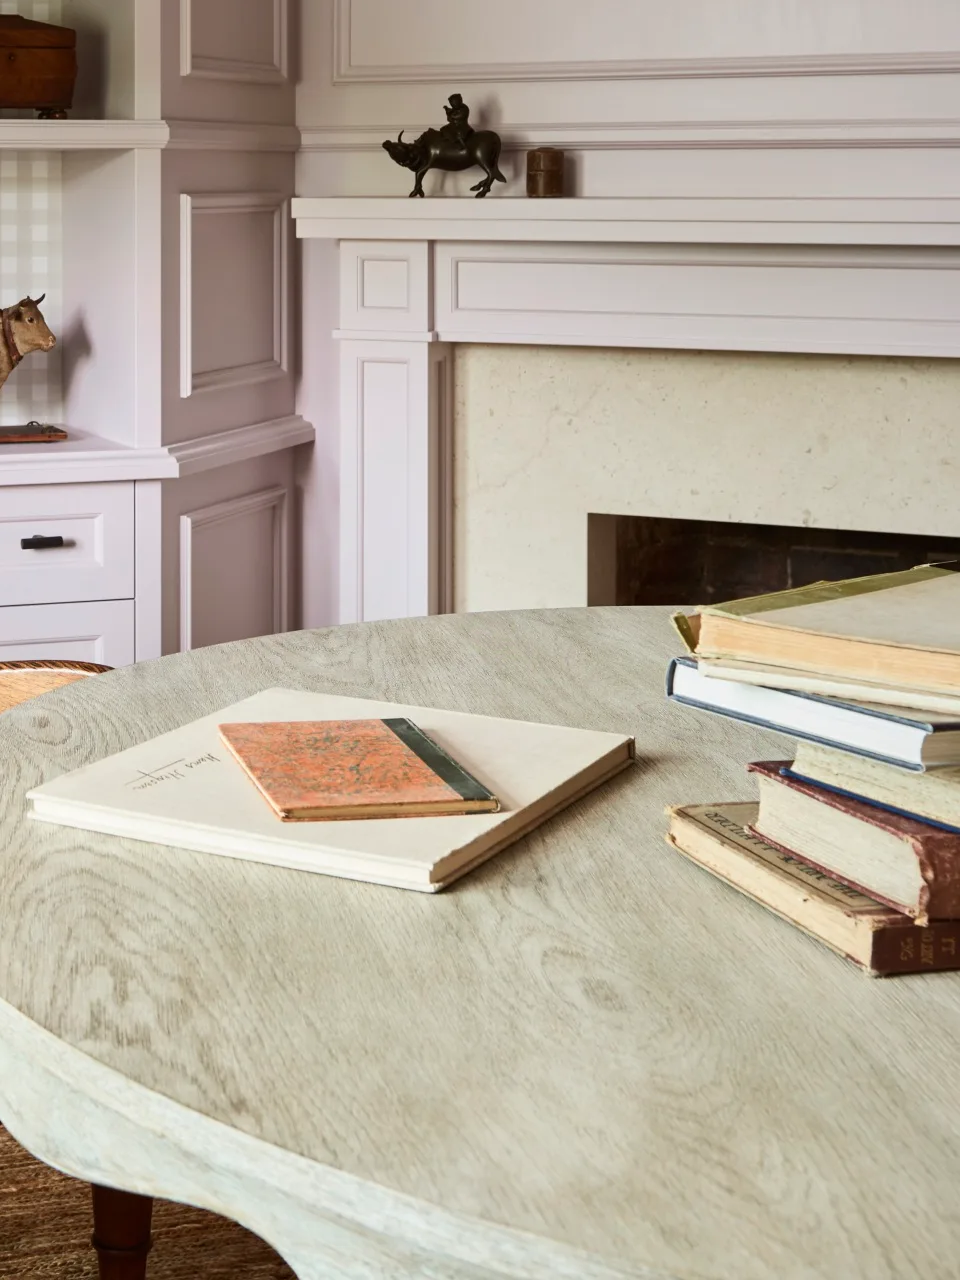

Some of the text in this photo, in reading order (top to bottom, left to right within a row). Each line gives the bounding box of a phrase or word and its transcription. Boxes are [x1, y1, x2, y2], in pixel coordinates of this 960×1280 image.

[827, 880, 861, 900] THE
[899, 937, 914, 961] The
[920, 942, 935, 966] ART
